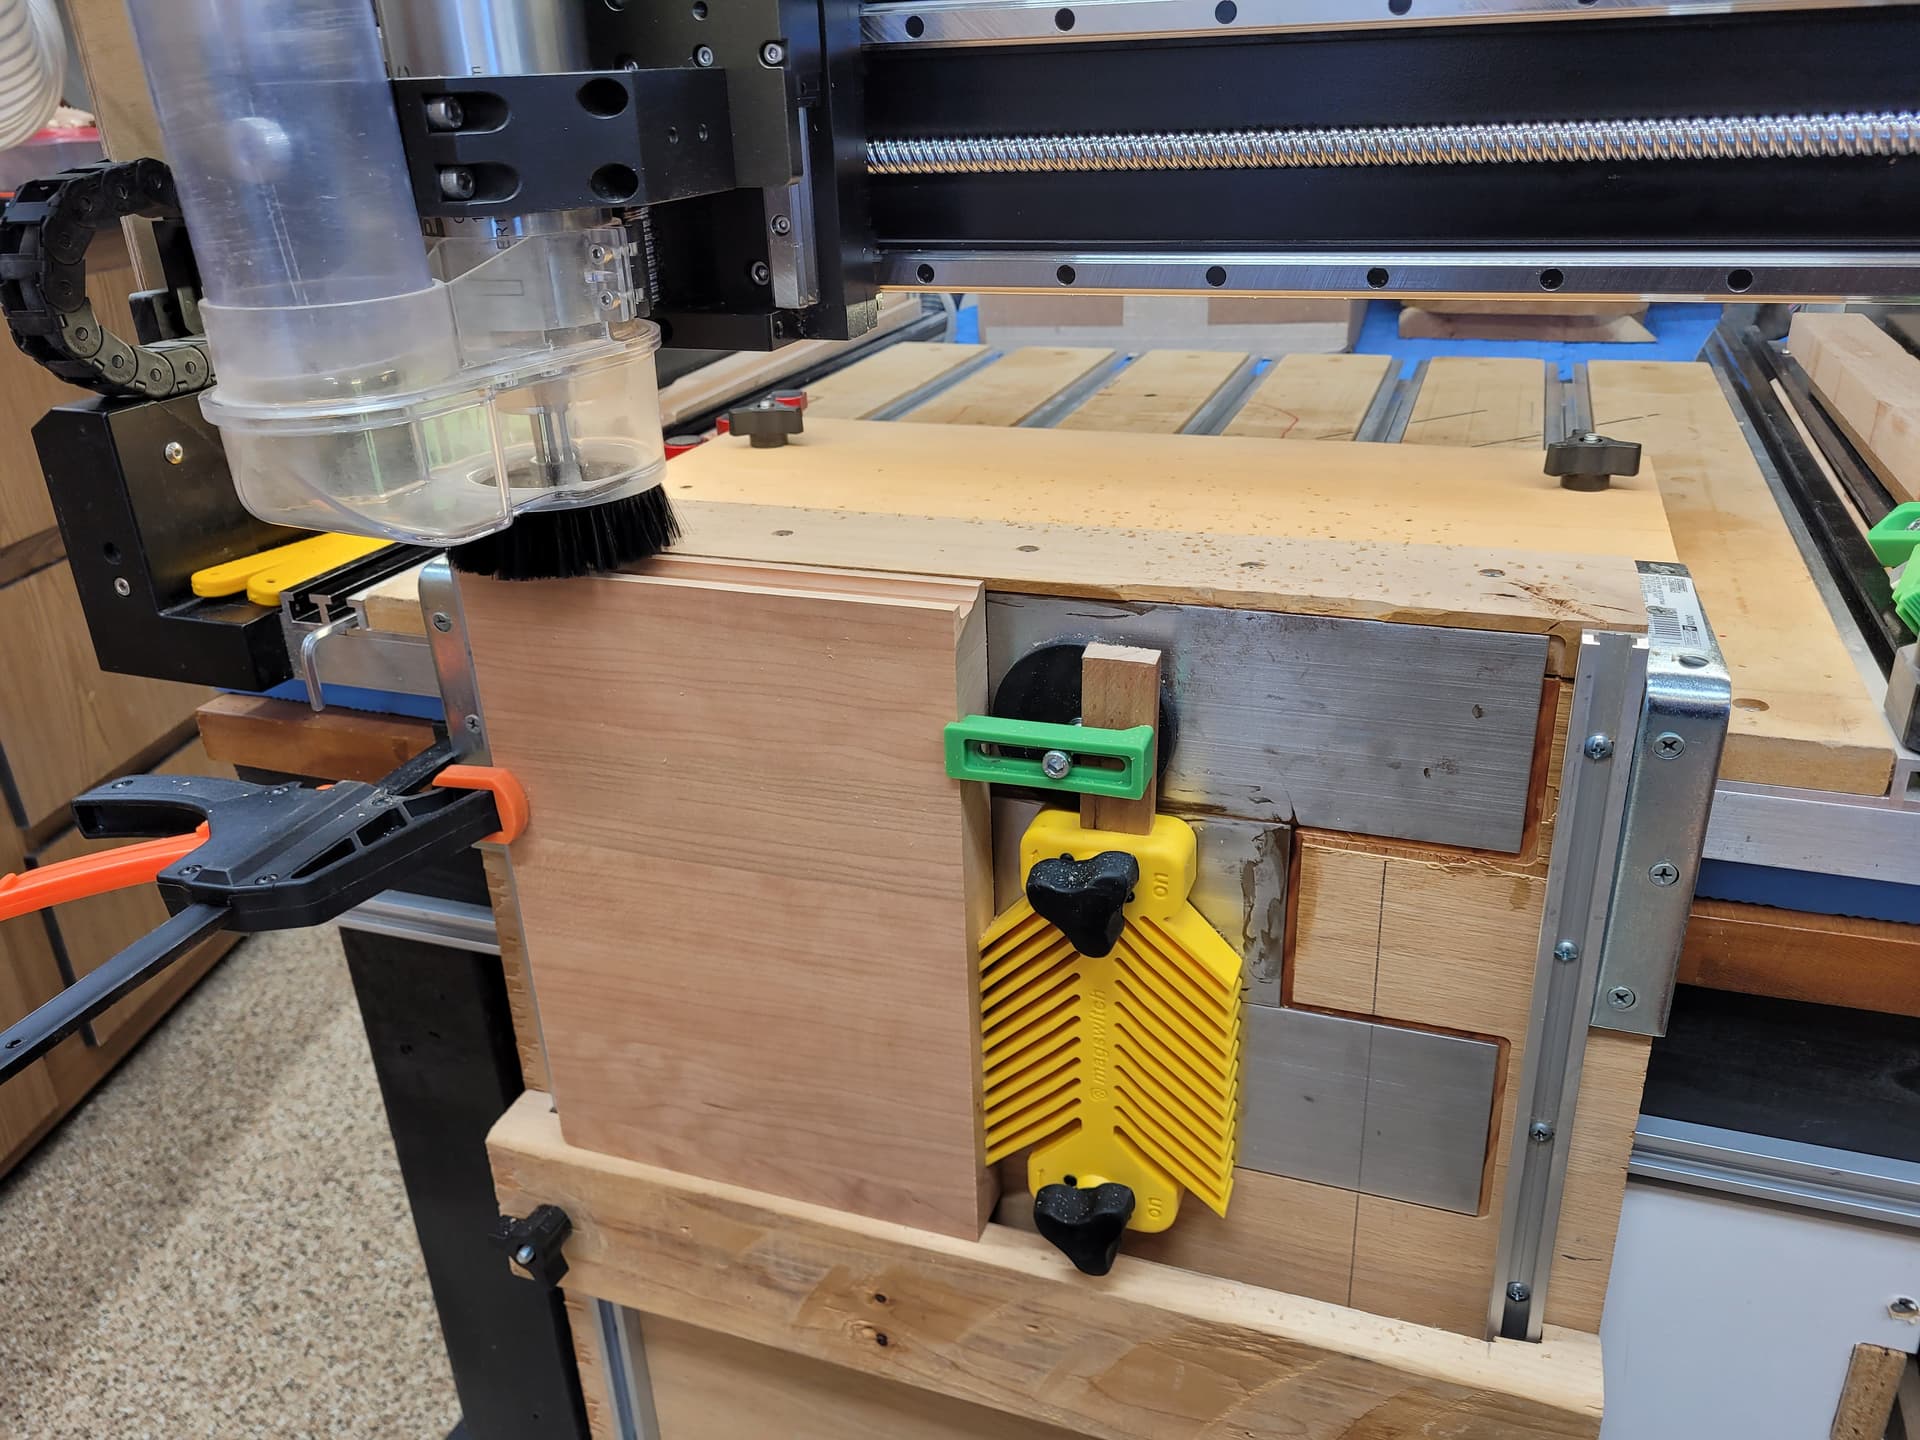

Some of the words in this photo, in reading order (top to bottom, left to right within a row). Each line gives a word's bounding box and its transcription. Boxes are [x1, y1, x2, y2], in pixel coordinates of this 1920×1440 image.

[1153, 872, 1169, 898] on
[1089, 989, 1109, 1085] magswitch
[1147, 1196, 1162, 1218] on
